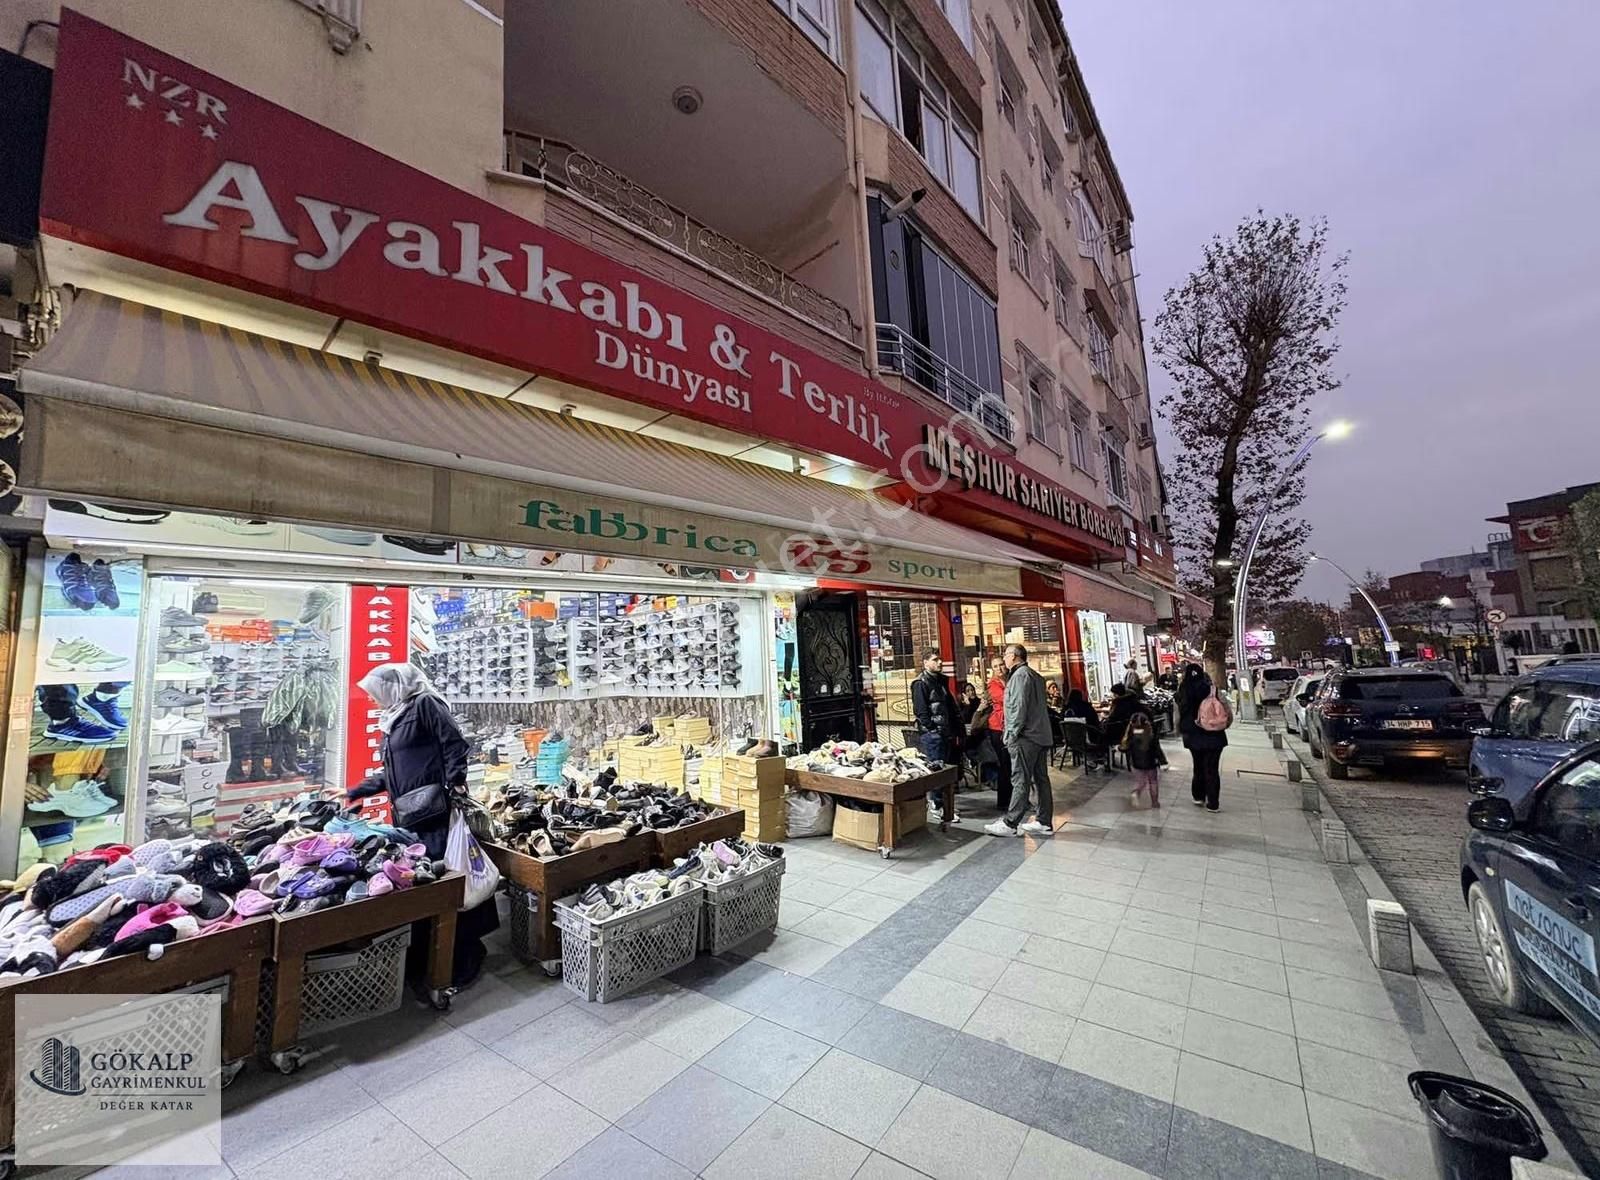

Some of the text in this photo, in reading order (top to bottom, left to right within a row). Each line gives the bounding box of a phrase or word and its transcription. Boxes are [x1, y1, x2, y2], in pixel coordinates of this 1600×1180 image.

[121, 57, 229, 125] NZR
[161, 159, 894, 460] Ayakkabı & Terlik
[595, 329, 752, 414] Dünyası
[924, 424, 1018, 500] MEŞHUR
[1020, 472, 1079, 527] SARIYER
[518, 500, 761, 558] fabbrica
[888, 559, 957, 581] sport
